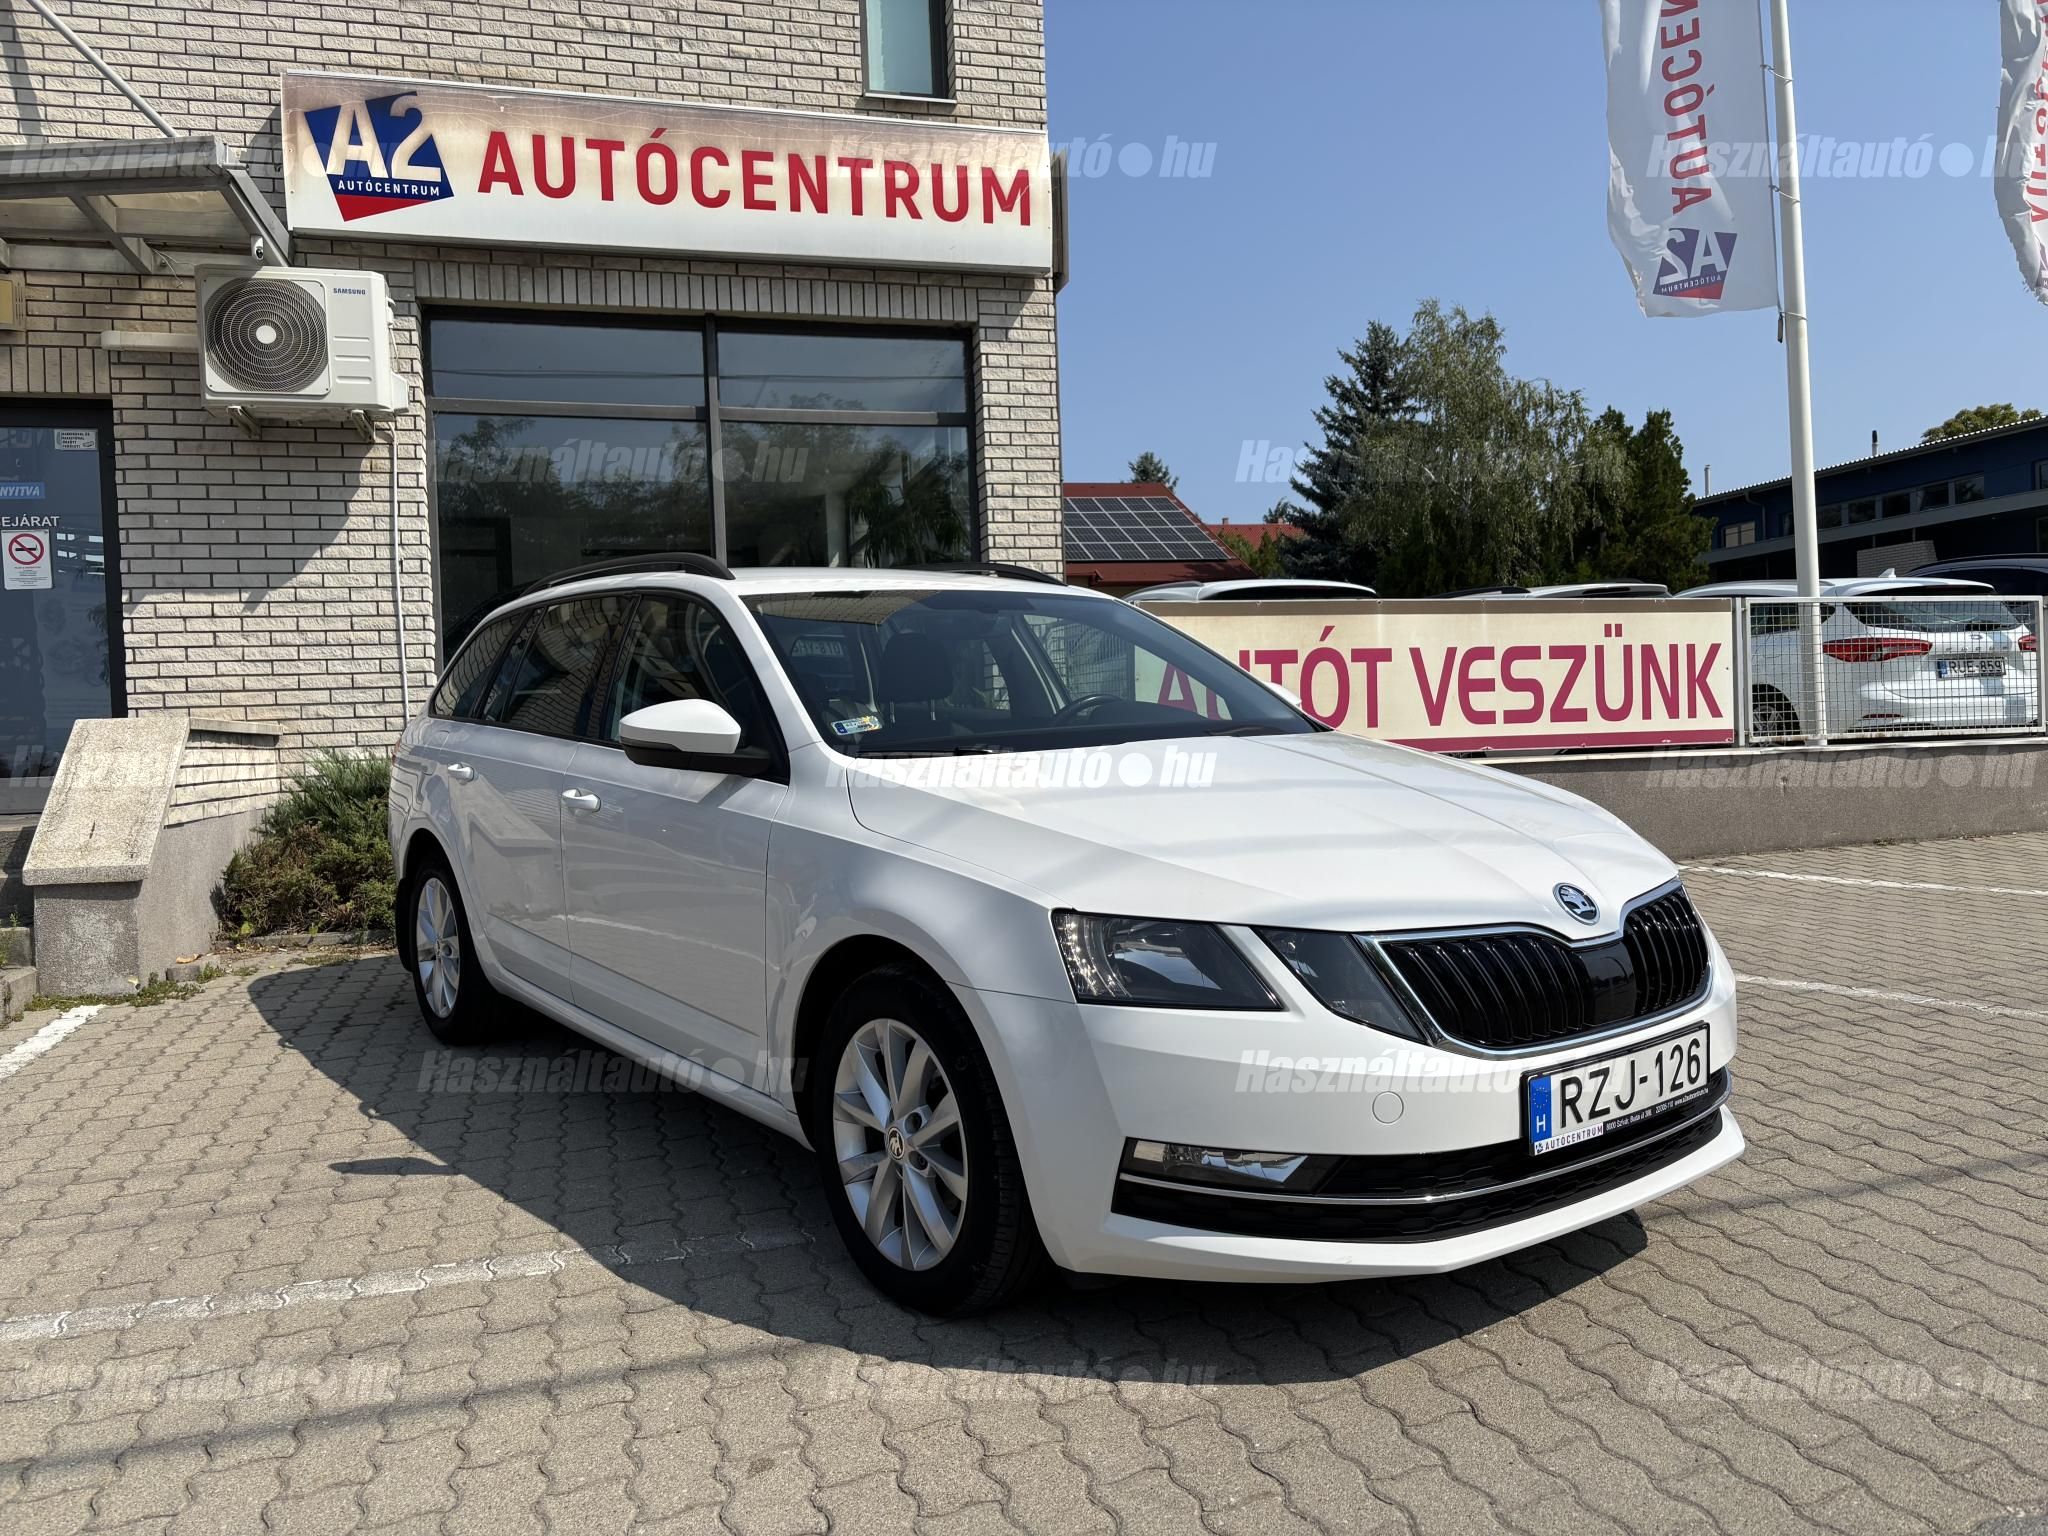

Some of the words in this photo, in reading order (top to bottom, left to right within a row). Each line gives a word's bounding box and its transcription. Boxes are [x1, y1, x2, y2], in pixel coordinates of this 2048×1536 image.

[326, 95, 441, 182] A2
[477, 127, 1031, 226] AUTÓCENTRUM
[338, 180, 440, 196] AUTÓCENTRUM
[333, 287, 366, 295] SAMSUNG
[0, 486, 40, 496] NYITVA
[0, 514, 60, 527] EJÁRAT
[1409, 623, 1723, 727] VESZÜNK
[1560, 1037, 1701, 1129] RZJ-126
[1535, 1113, 1546, 1133] H
